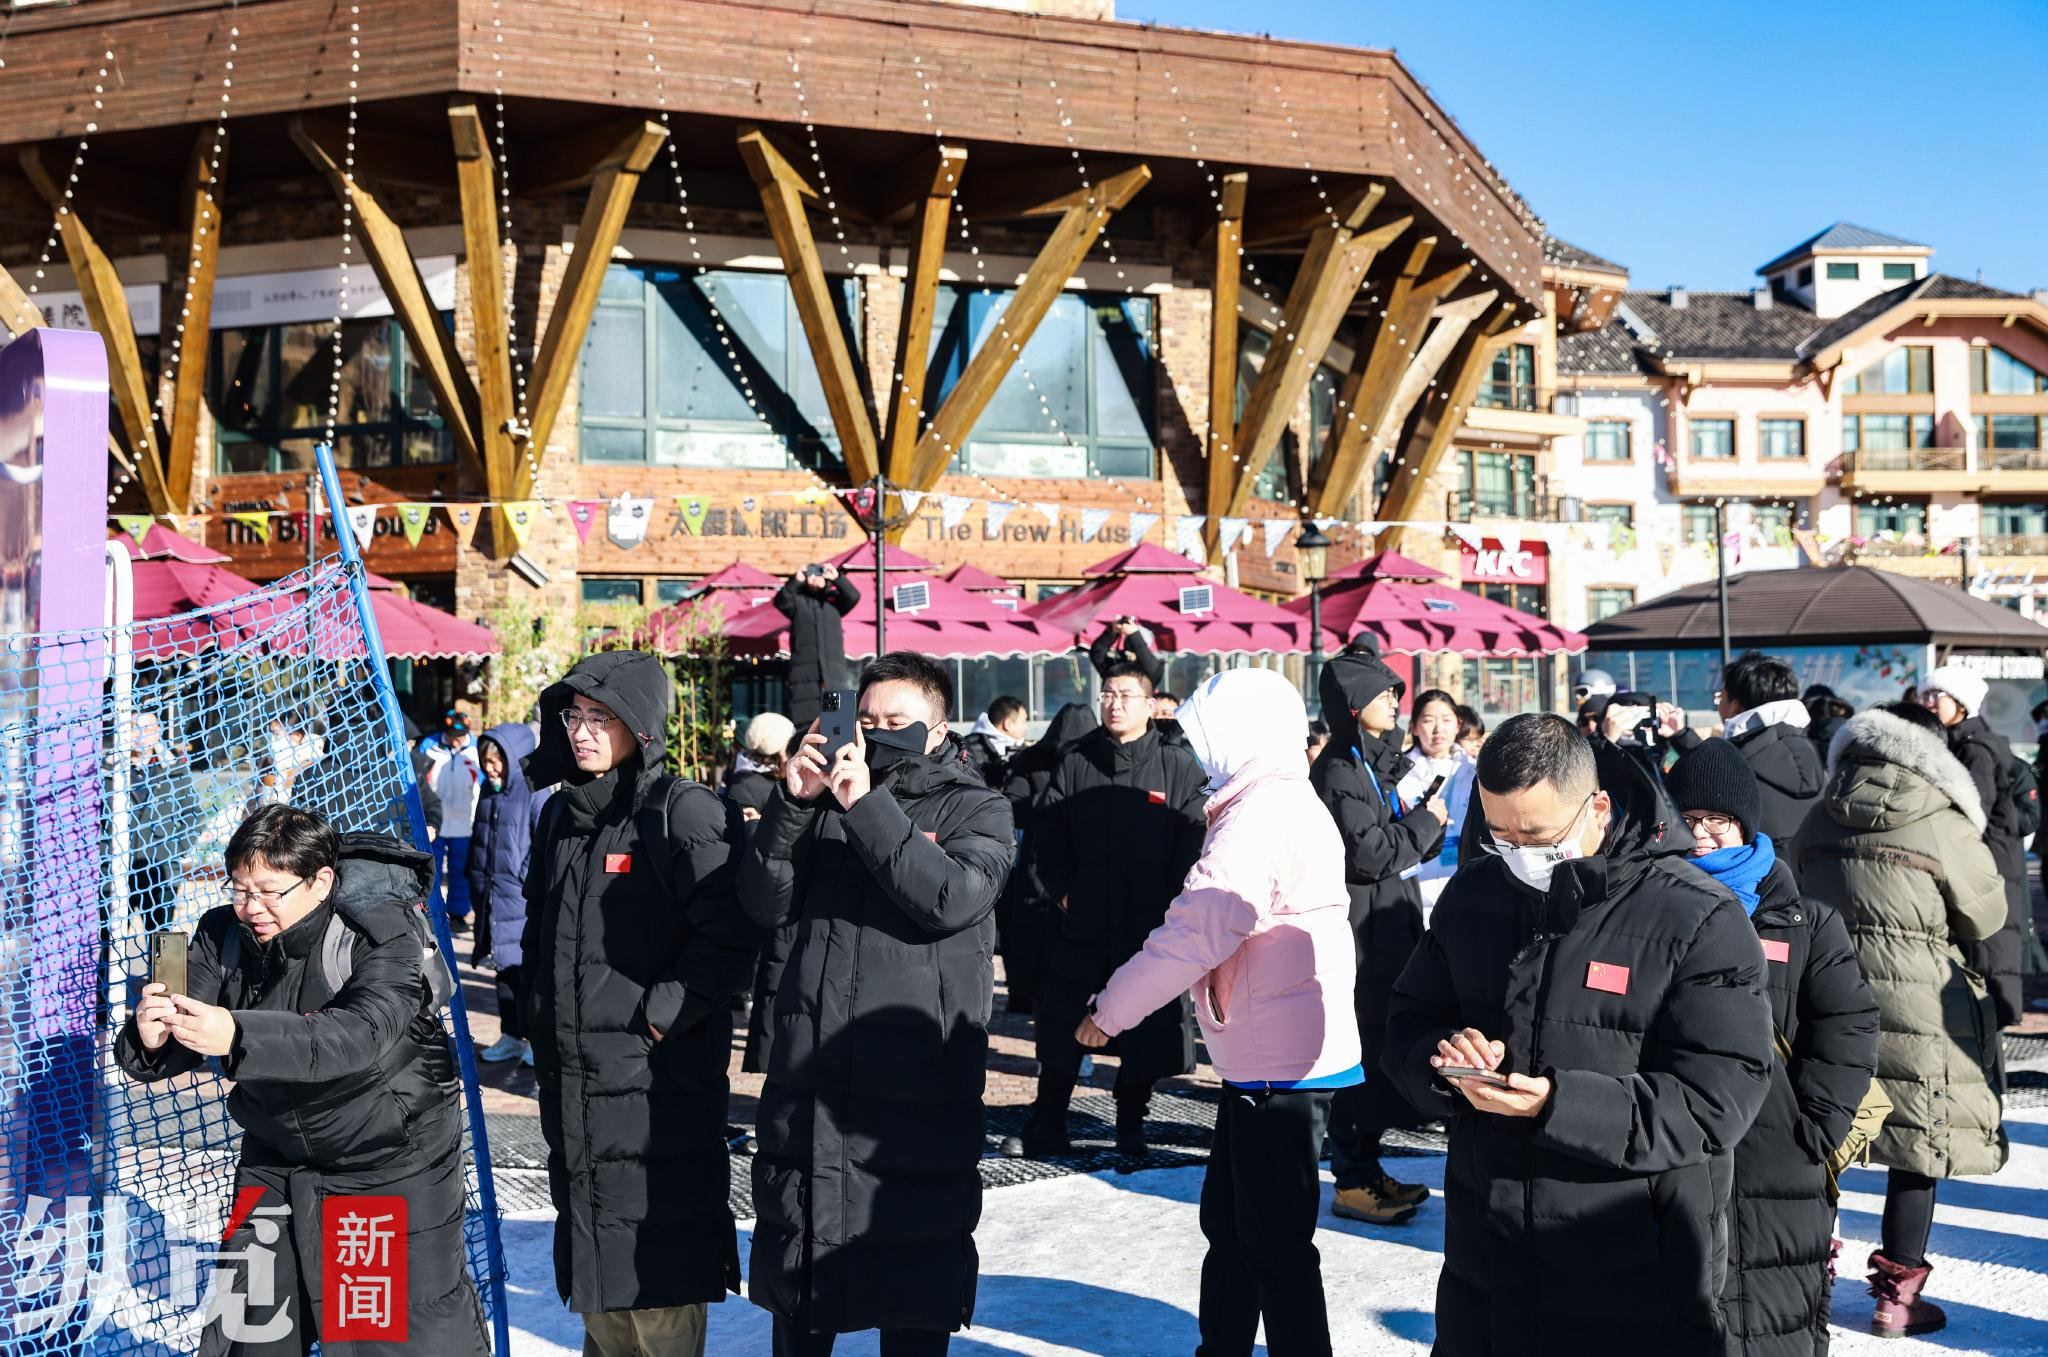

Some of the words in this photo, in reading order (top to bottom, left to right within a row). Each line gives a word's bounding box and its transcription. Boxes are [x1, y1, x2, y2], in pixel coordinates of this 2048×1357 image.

[223, 516, 273, 544] Th
[1059, 514, 1143, 544] Hus
[1474, 550, 1533, 577] KFC
